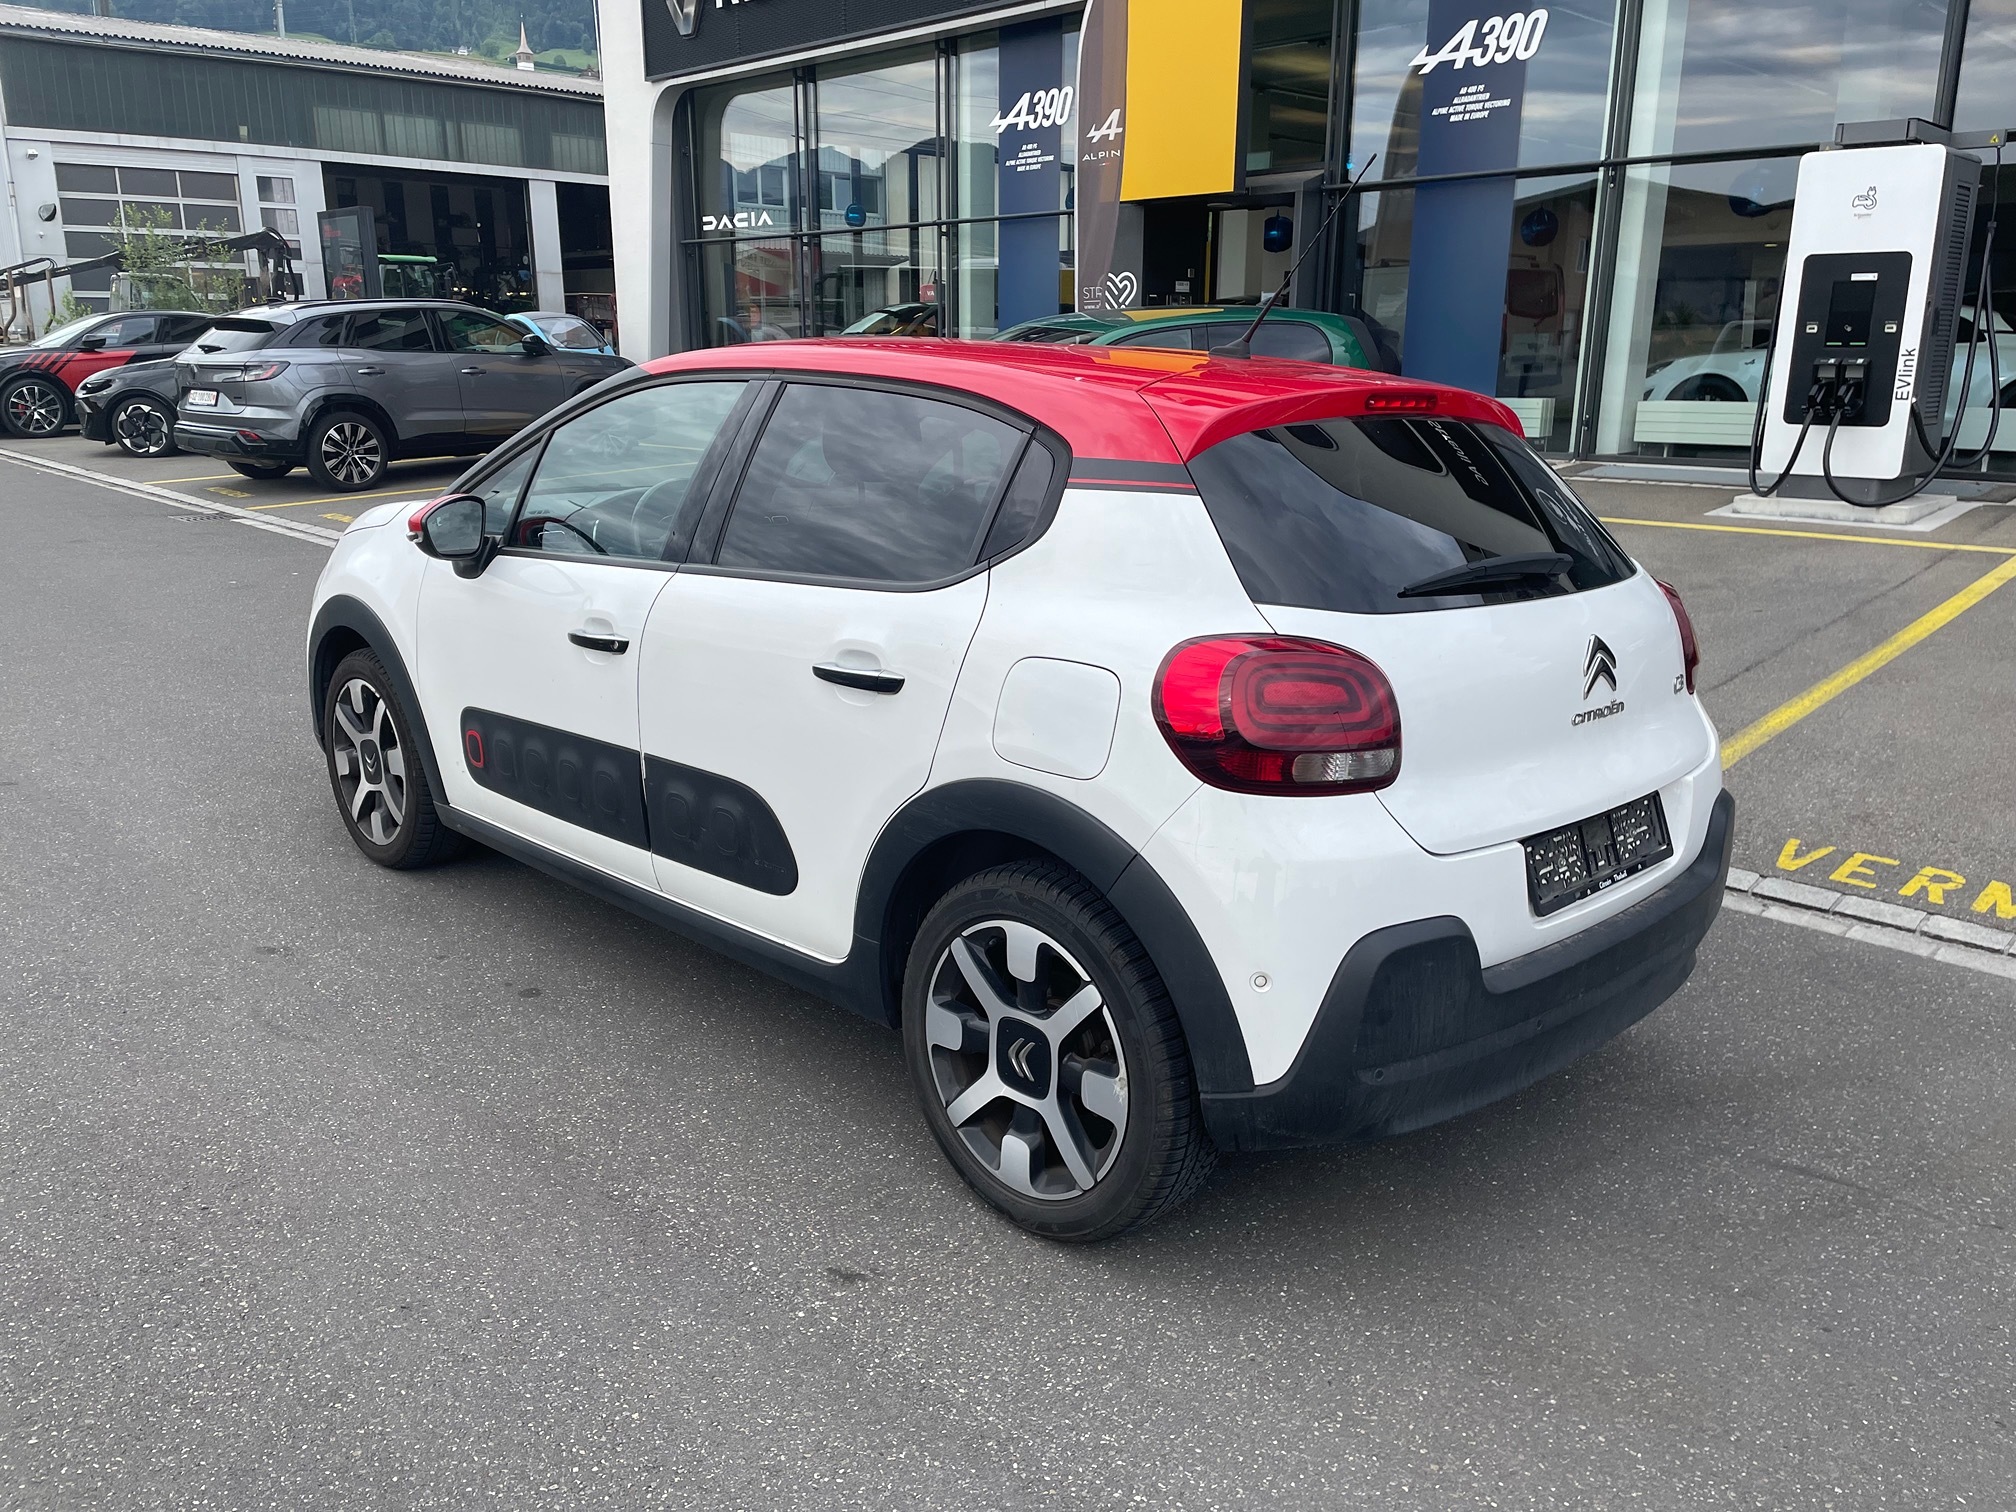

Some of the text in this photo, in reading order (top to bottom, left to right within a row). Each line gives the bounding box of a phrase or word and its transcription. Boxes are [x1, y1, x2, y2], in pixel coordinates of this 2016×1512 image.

[1082, 149, 1121, 161] ALPIN
[702, 210, 774, 231] DACIA
[1895, 348, 1916, 401] EVlink
